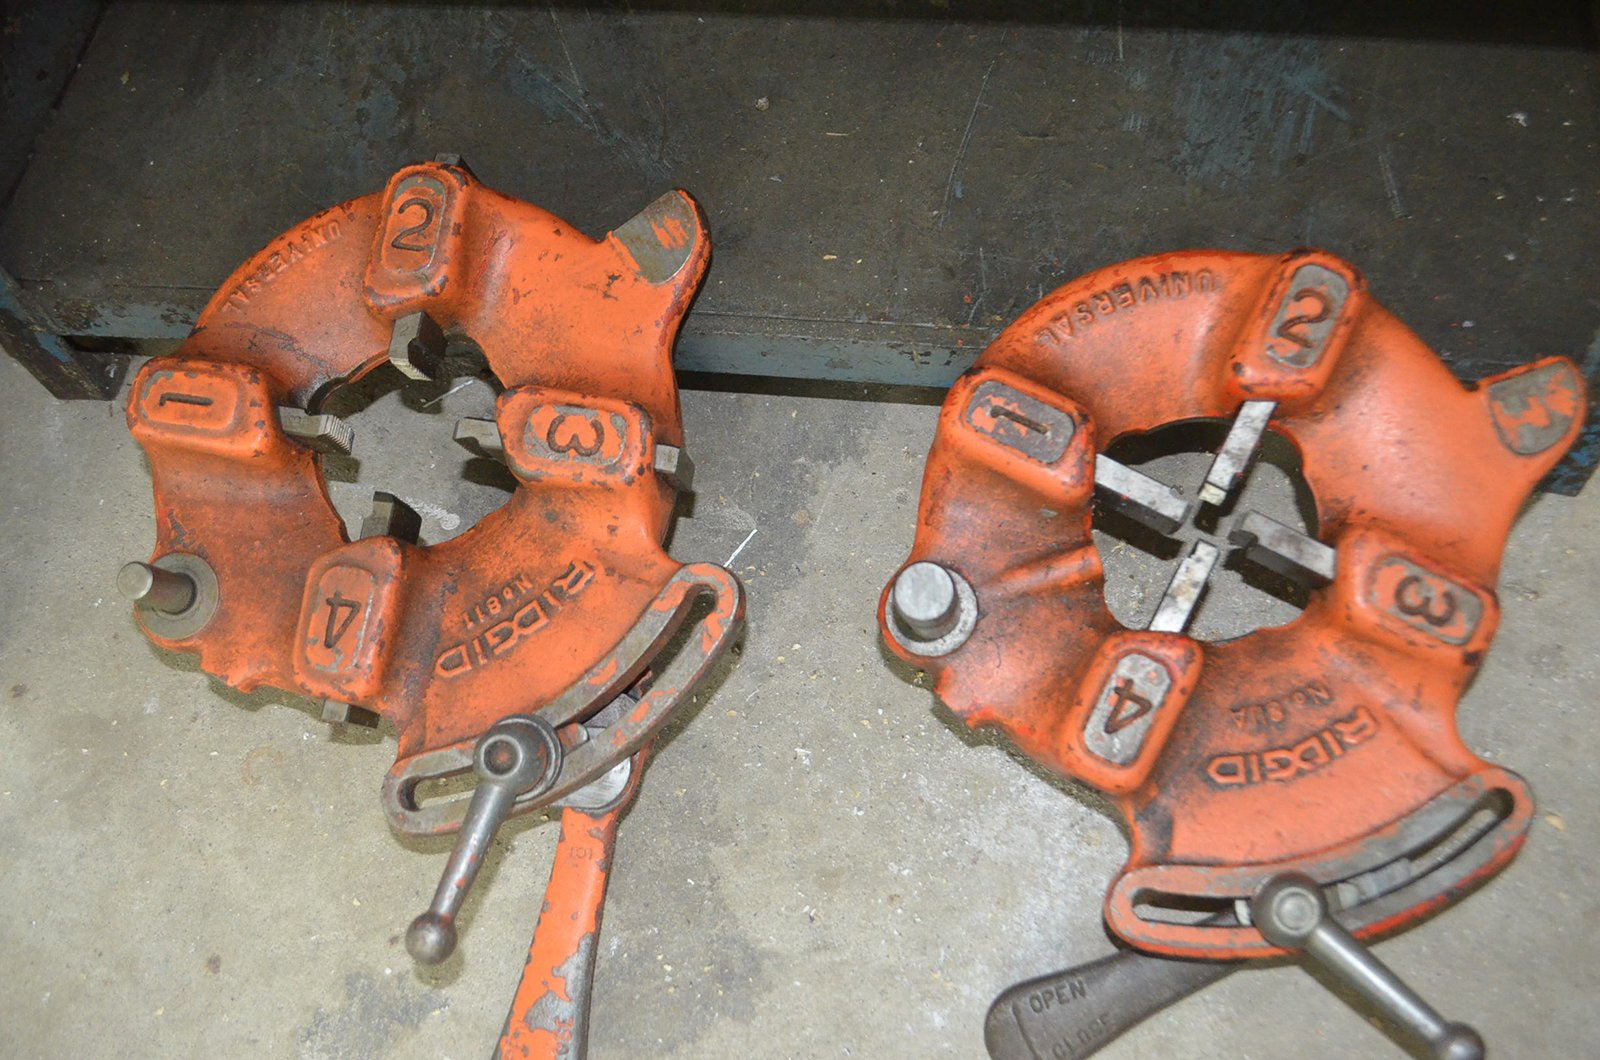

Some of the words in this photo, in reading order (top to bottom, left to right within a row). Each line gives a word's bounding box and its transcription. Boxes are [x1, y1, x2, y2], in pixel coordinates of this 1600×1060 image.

[391, 198, 434, 252] 2
[1034, 268, 1216, 345] UNIVERSAL
[1277, 288, 1330, 348] 2
[159, 392, 213, 407] 1
[990, 404, 1051, 435] 1
[547, 414, 604, 457] 3
[324, 590, 361, 649] 4
[435, 560, 595, 678] RIDGID
[1395, 575, 1457, 628] 3
[1103, 678, 1153, 735] 4
[1206, 705, 1379, 785] RIDGID
[1028, 979, 1087, 1015] OPEN
